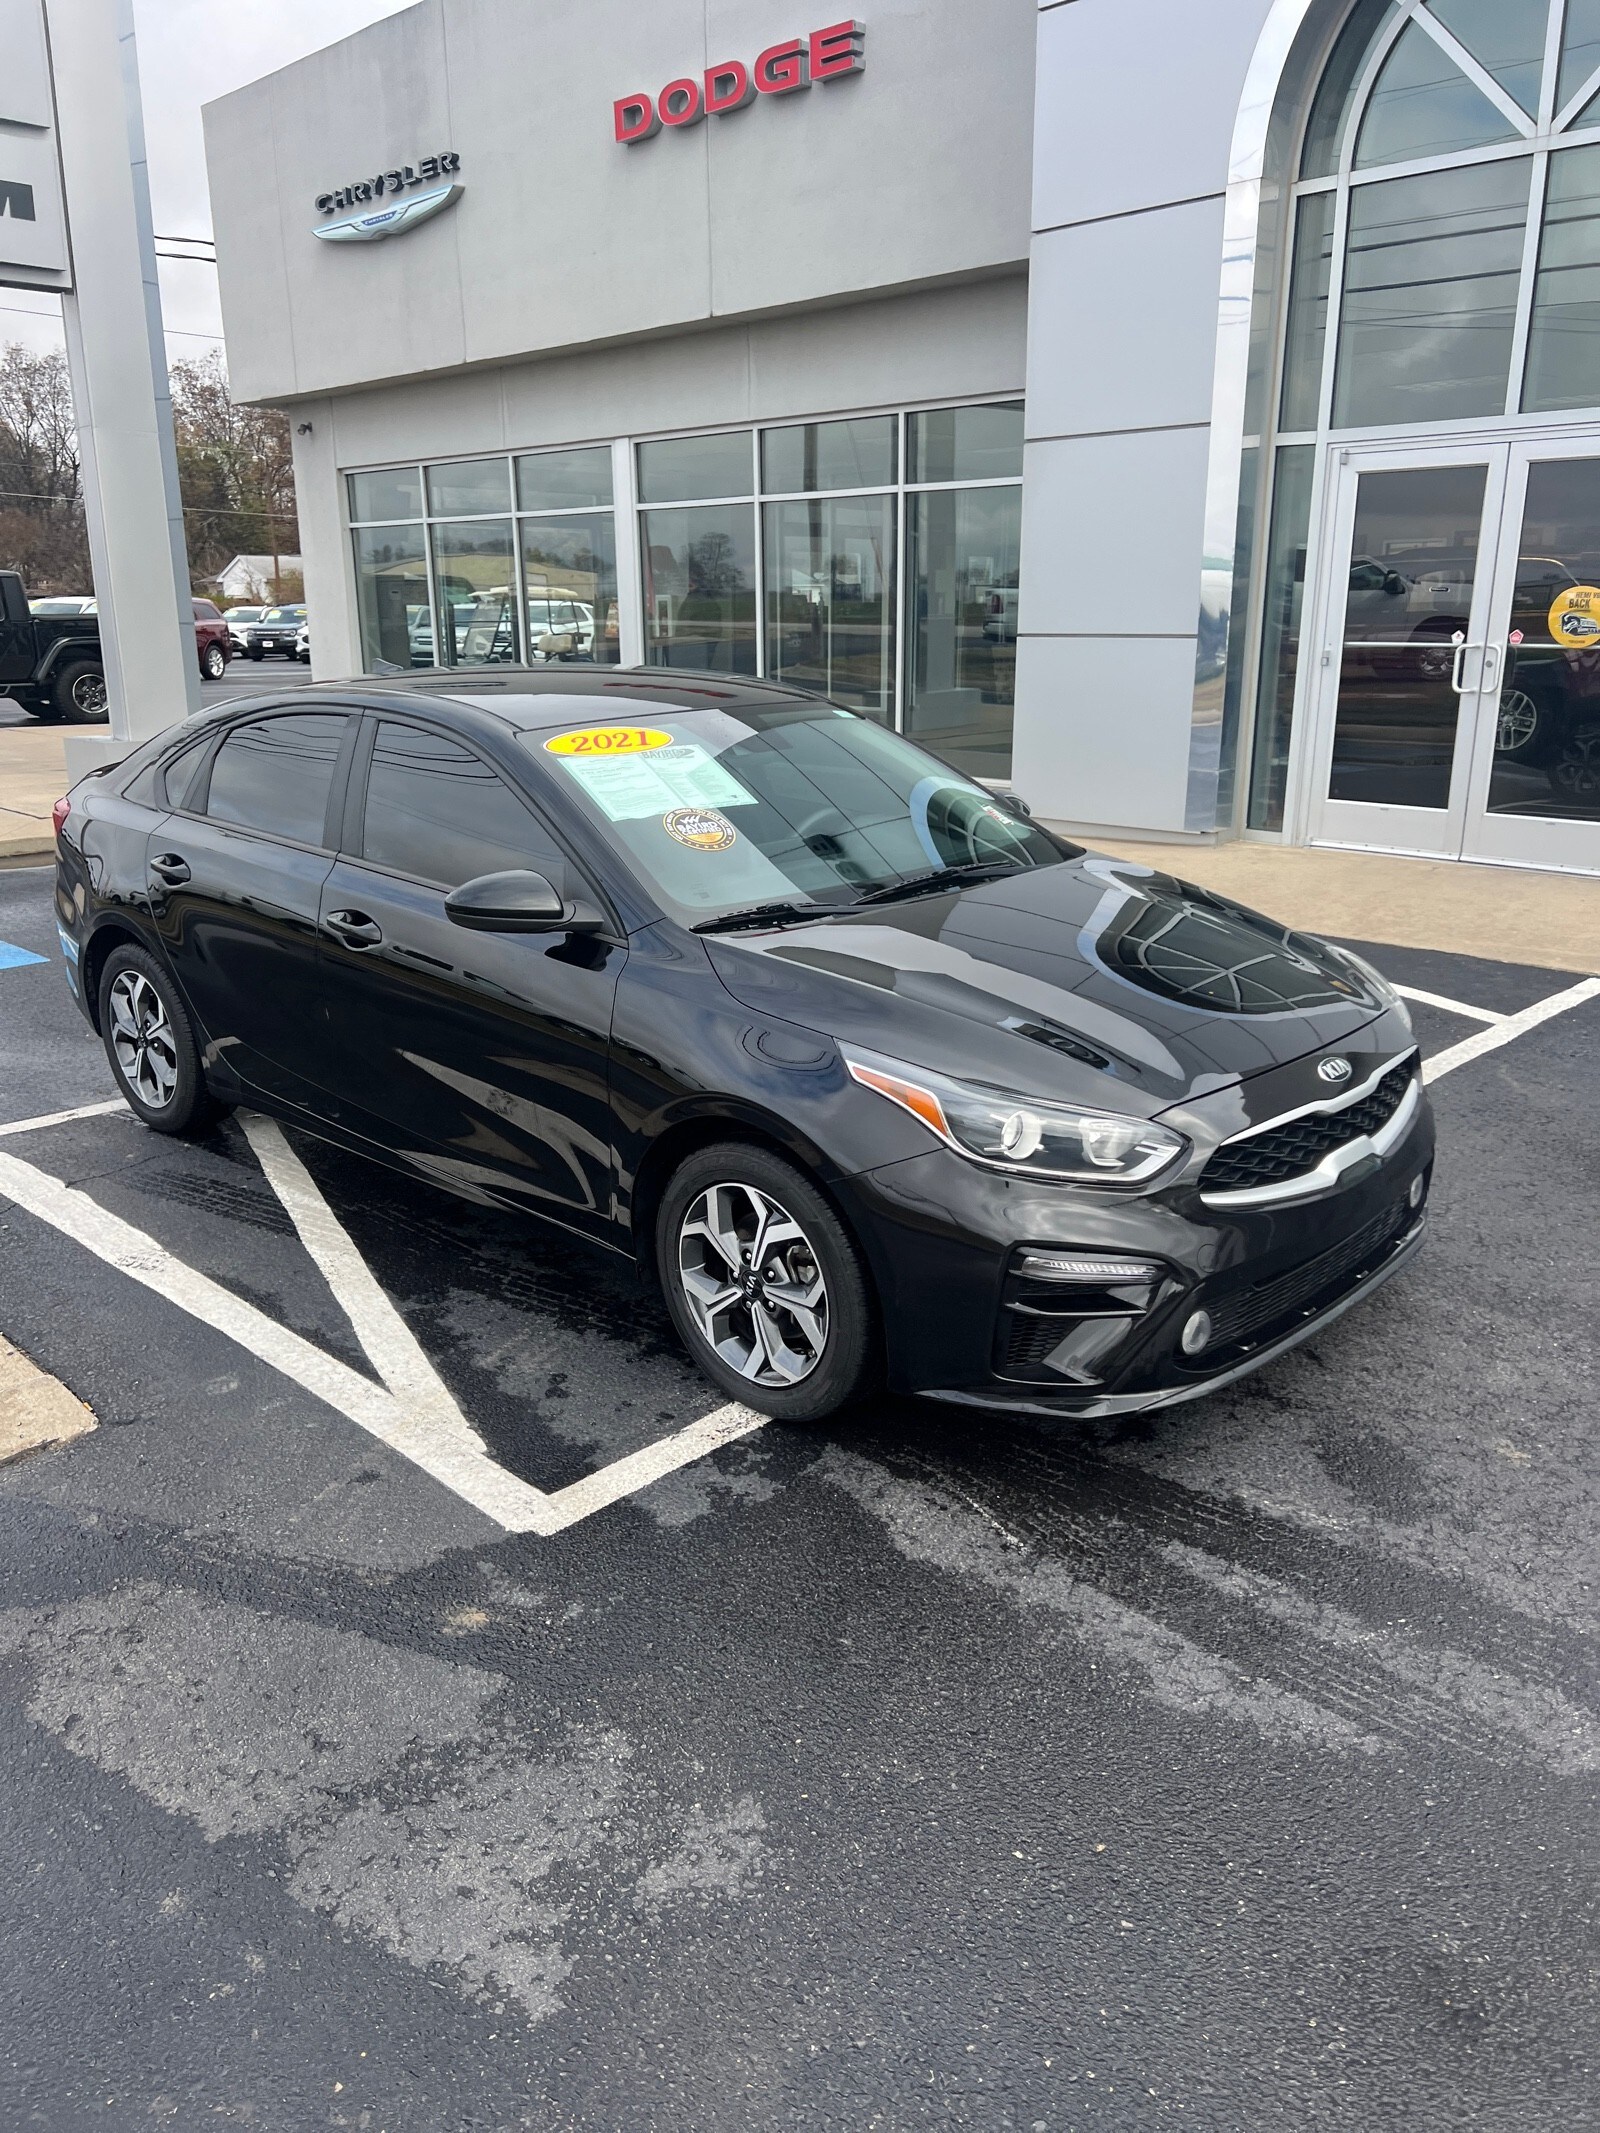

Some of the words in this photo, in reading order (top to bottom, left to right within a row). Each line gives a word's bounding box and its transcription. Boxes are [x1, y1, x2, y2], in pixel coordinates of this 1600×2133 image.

[613, 19, 863, 143] DODGE
[315, 151, 460, 213] CHRYSLER
[1568, 599, 1591, 609] BACK
[571, 730, 652, 753] 2021
[676, 821, 718, 833] BAYIRD
[1321, 1059, 1350, 1079] KIA
